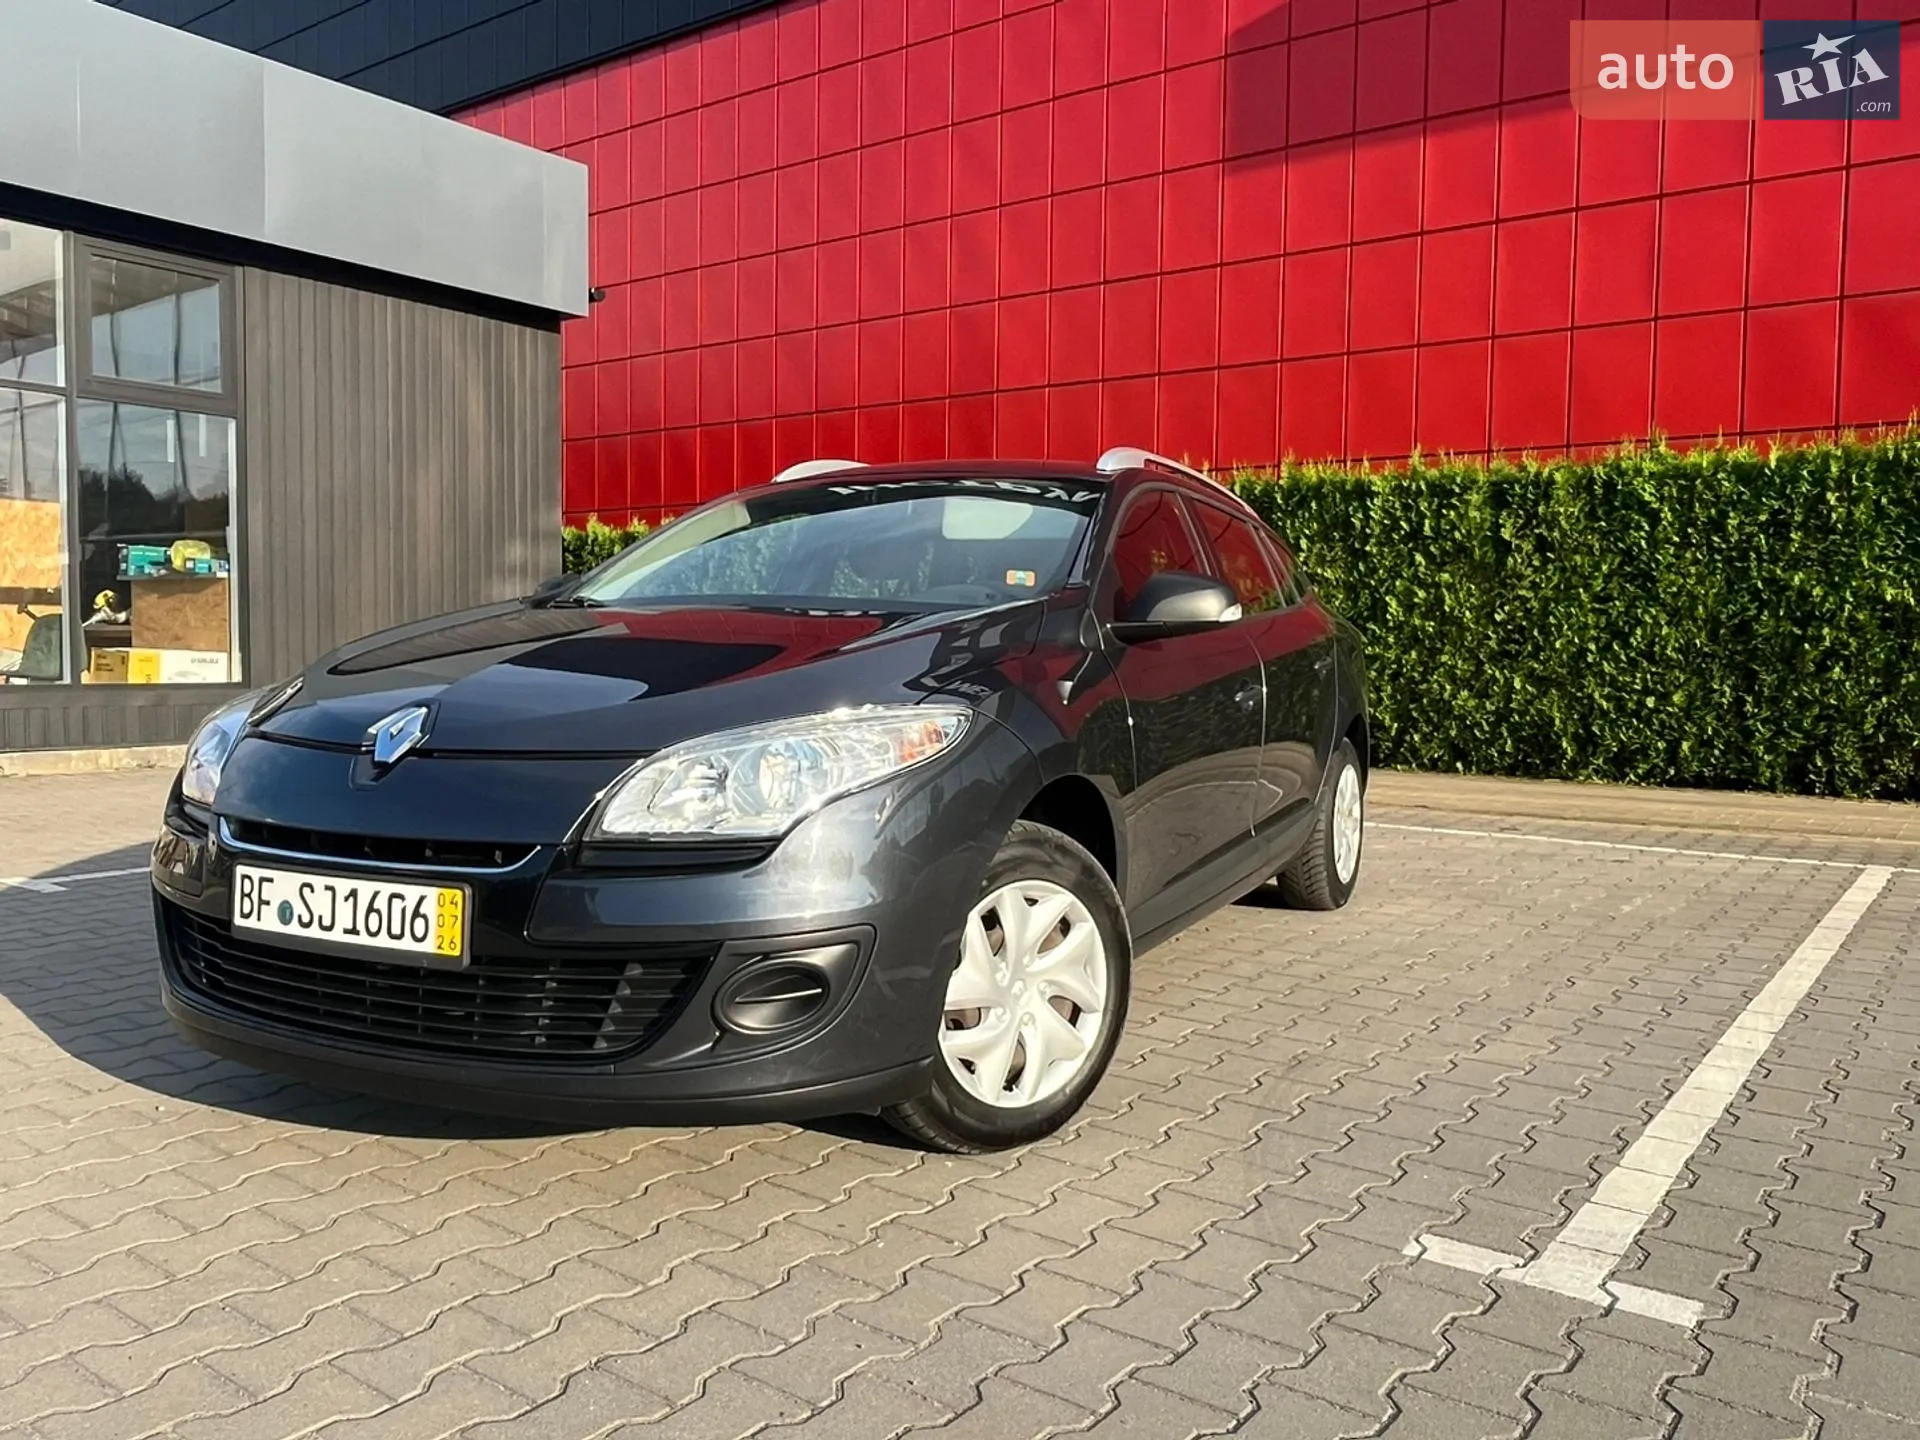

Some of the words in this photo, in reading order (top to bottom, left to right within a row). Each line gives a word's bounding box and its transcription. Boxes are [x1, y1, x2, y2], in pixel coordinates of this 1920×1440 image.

[239, 873, 275, 922] BF
[297, 881, 430, 943] SJ1606
[437, 892, 459, 909] 04
[437, 913, 459, 928] 07
[437, 934, 458, 951] 26
